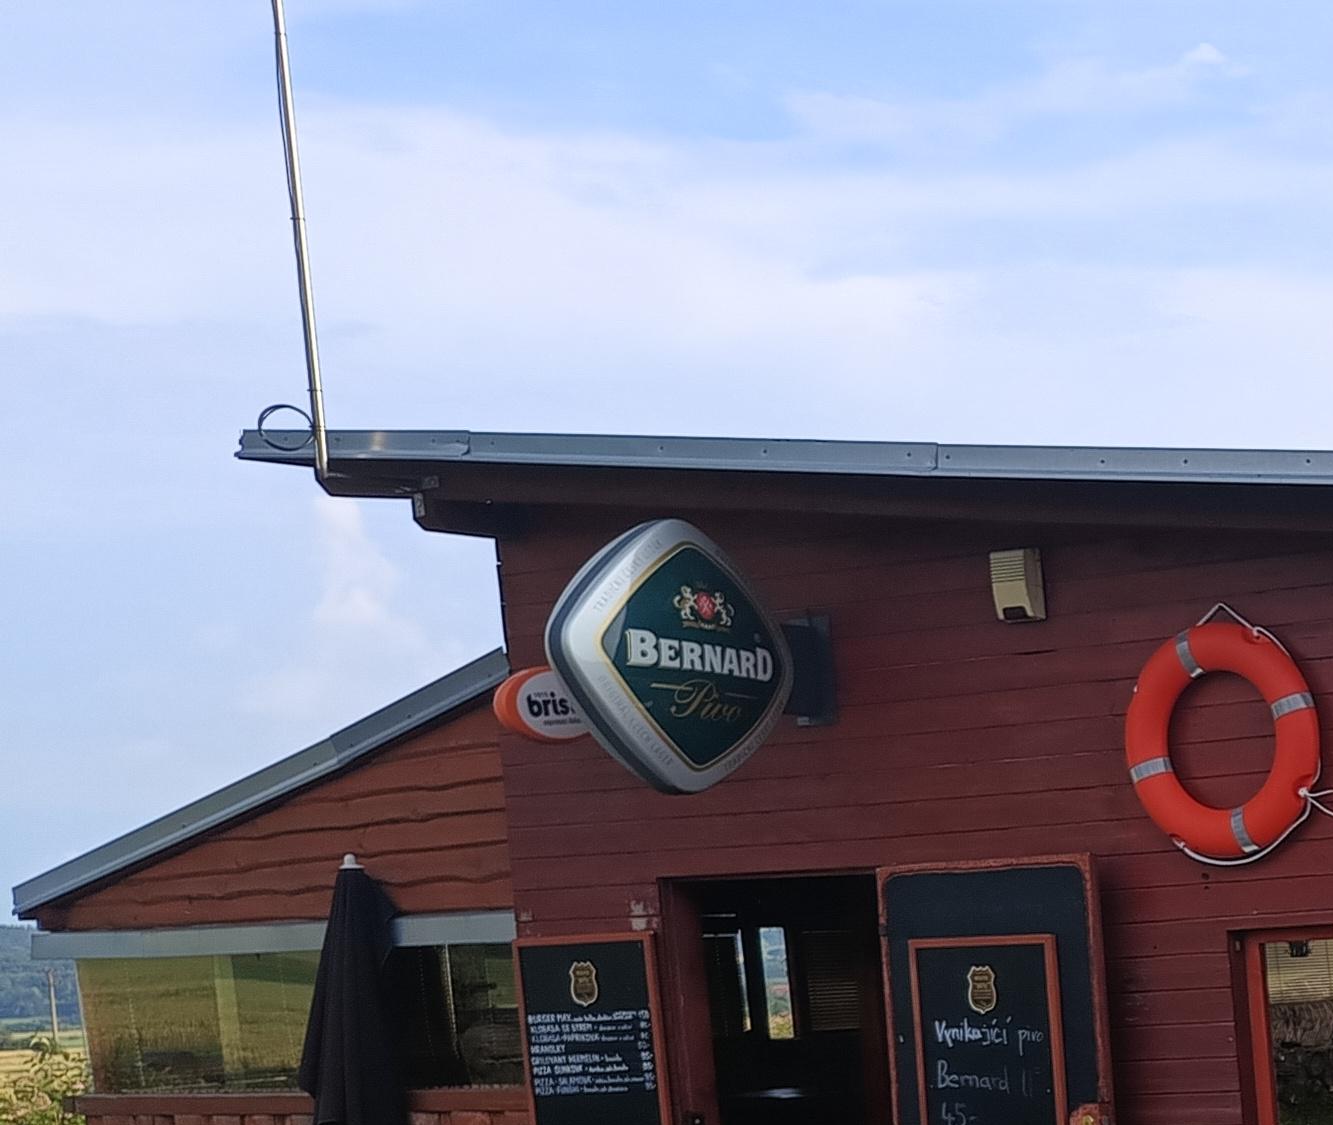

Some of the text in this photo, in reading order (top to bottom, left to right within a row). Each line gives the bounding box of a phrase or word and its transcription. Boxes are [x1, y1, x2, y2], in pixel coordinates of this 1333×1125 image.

[624, 628, 774, 682] BERNARD
[669, 679, 741, 721] Pivo
[935, 1016, 1044, 1056] Vynikající pivo
[937, 1059, 1010, 1094] Bernard
